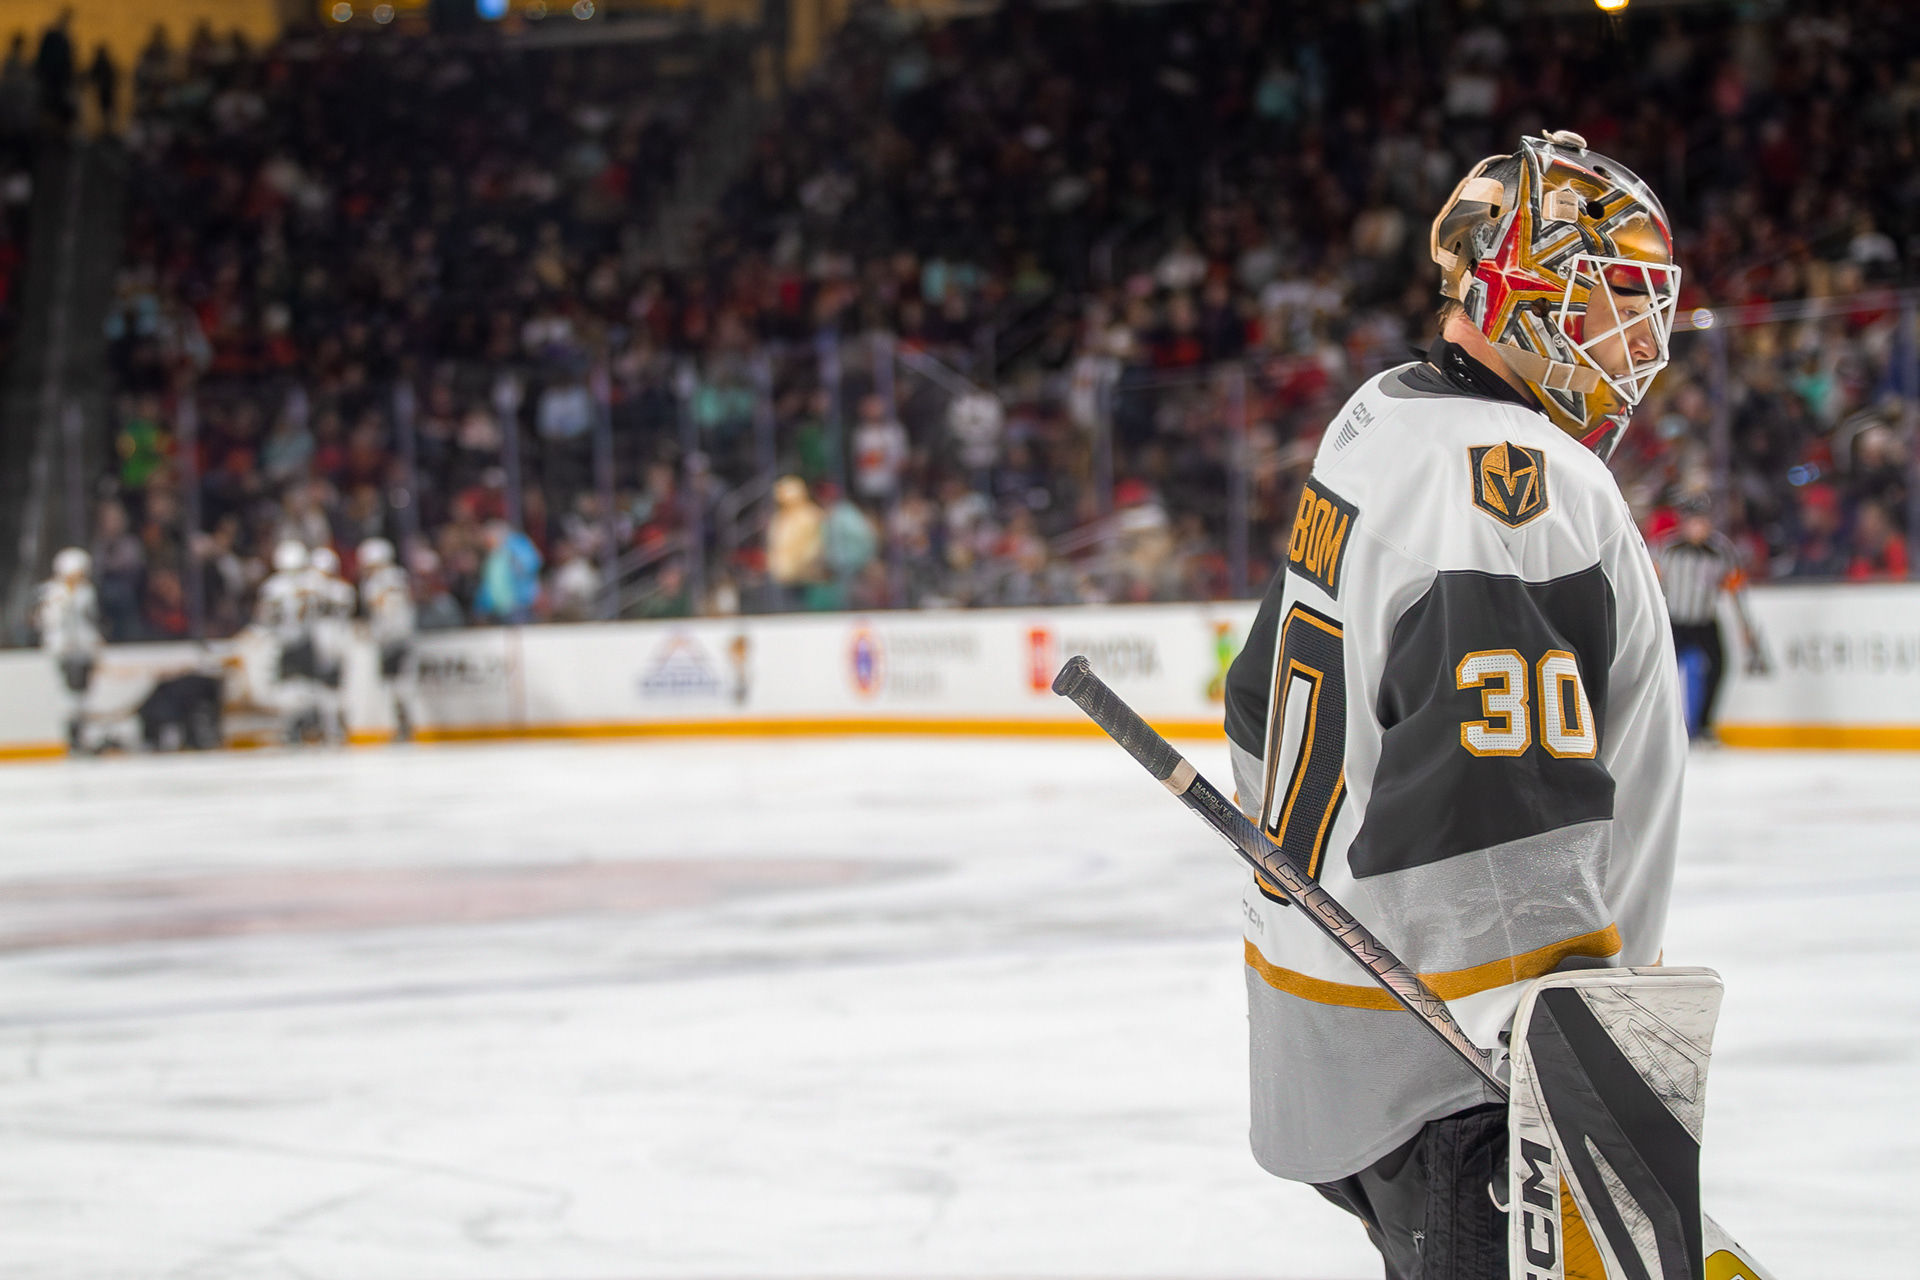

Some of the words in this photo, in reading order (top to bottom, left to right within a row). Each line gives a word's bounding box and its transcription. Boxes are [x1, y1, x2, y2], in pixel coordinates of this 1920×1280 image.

[1352, 401, 1376, 428] CCM
[1287, 483, 1350, 587] BOM
[1455, 648, 1598, 760] 30
[1194, 781, 1235, 818] NANOLITE
[1263, 849, 1401, 975] CCM
[1520, 1137, 1557, 1280] CM
